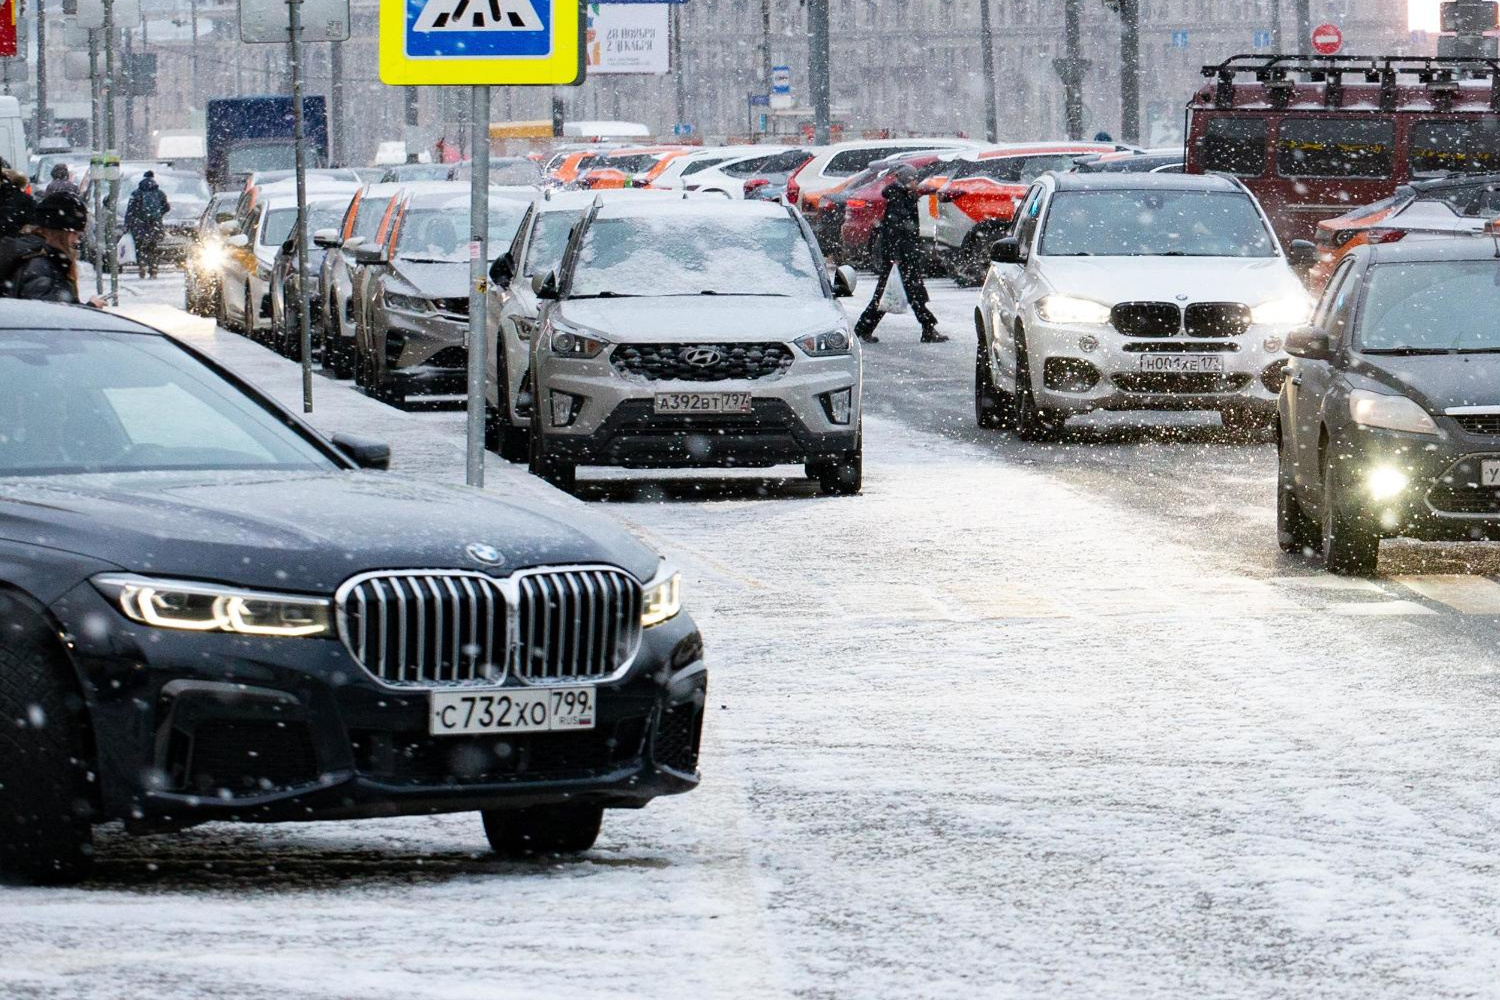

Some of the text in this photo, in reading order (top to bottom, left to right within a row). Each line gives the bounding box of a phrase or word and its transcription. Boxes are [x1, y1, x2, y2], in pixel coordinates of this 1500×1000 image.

[659, 394, 720, 410] А392ВТ
[441, 690, 590, 729] С732ХО 799
